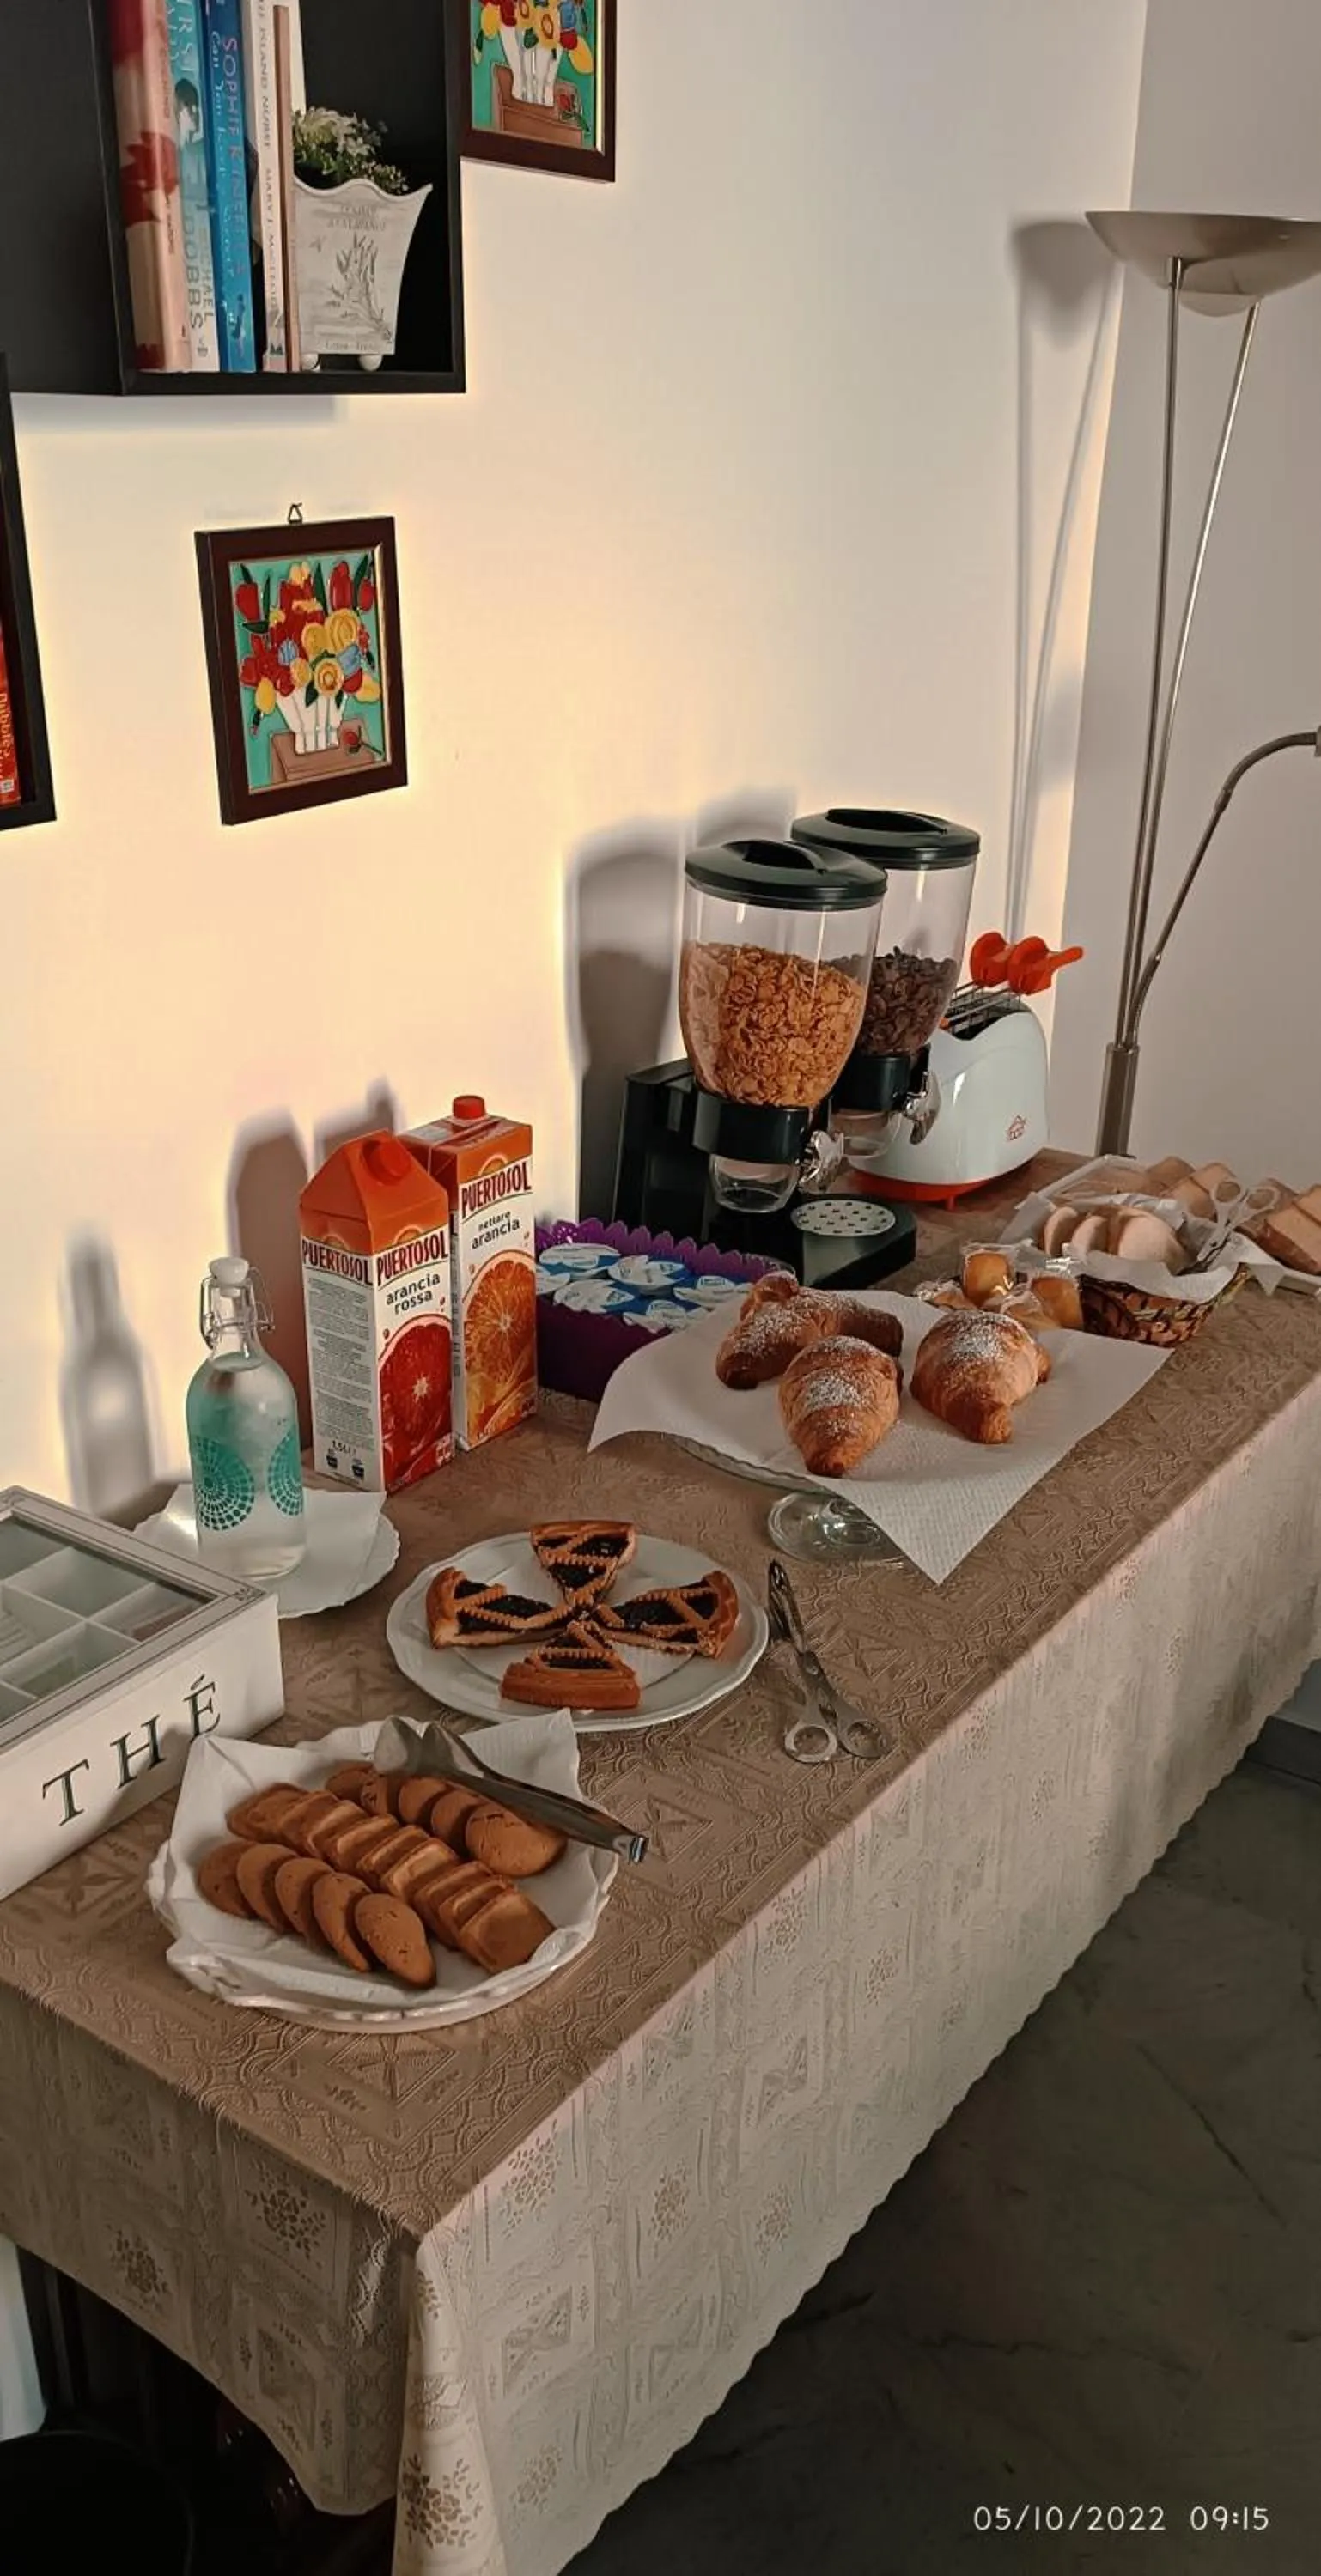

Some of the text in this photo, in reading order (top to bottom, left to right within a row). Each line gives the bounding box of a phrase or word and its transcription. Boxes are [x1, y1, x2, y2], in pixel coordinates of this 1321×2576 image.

[259, 27, 269, 89] ISLAND
[222, 37, 241, 137] SOPHIE
[183, 215, 204, 330] DOBBS
[460, 1163, 532, 1219] PUERTOSOL
[301, 1238, 374, 1286] PUERTOSOL
[376, 1228, 448, 1286] PUERTOSOL
[471, 1218, 520, 1250] arancia
[385, 1272, 441, 1305] arancia
[393, 1290, 434, 1315] rossa
[41, 1674, 222, 1826] THÉ
